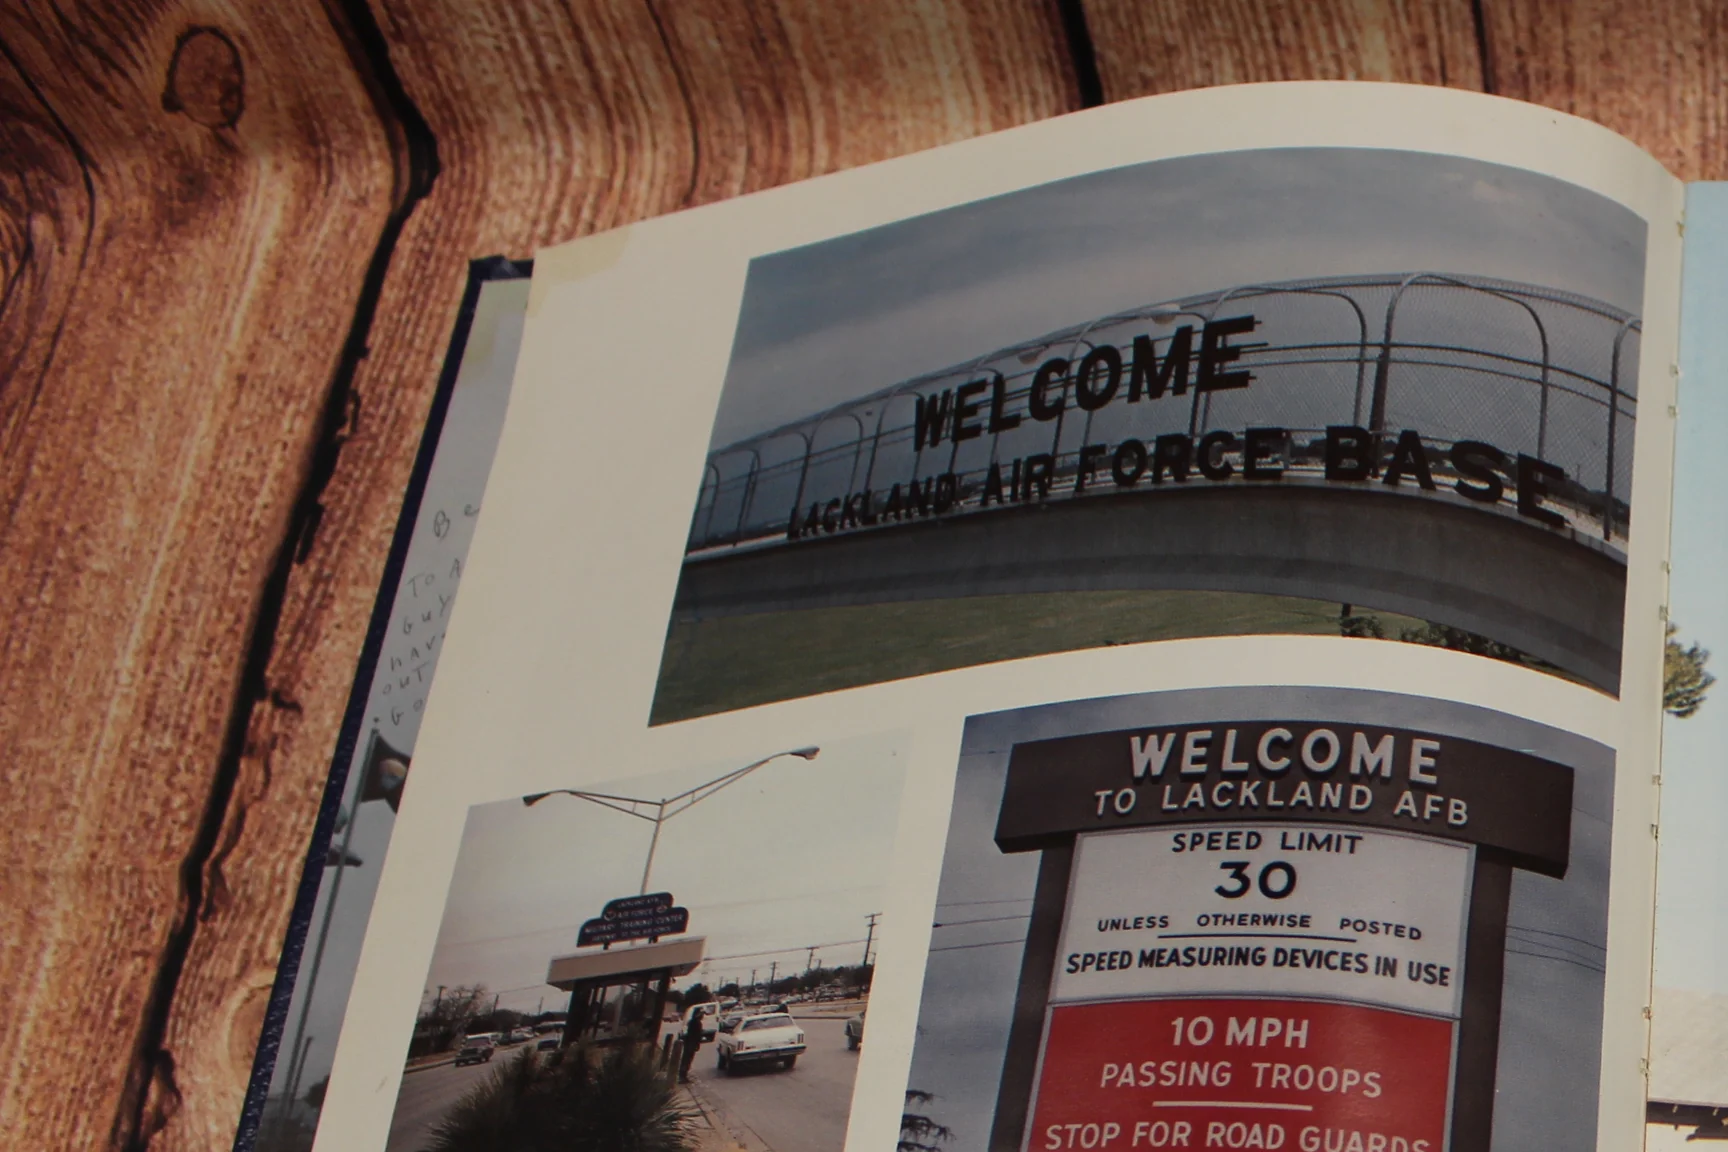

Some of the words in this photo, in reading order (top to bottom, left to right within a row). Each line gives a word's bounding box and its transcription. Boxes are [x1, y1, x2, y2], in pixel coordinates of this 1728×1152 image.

[912, 315, 1260, 452] WELCOME
[787, 473, 956, 541] LACKLAND
[980, 453, 1052, 506] AIR
[1075, 427, 1287, 492] FORCE
[1325, 425, 1566, 528] BASE
[1129, 727, 1442, 785] WELCOME
[1095, 788, 1137, 815] TO
[1162, 781, 1373, 811] LACKLAND
[1394, 791, 1469, 826] AFB
[1171, 831, 1262, 854] SPEED
[1280, 831, 1363, 855] LIMIT
[1214, 861, 1297, 900] 30
[1097, 915, 1170, 932] UNLESS
[1197, 914, 1312, 929] OTHERWISE
[1340, 918, 1422, 940] POSTED
[1066, 951, 1133, 974] SPEED
[1138, 947, 1267, 970] MEASURING
[1273, 949, 1369, 975] DEVICES
[1374, 956, 1397, 979] IN
[1407, 962, 1451, 988] USE
[1170, 1016, 1213, 1047] 10
[1224, 1018, 1309, 1049] MPH
[1101, 1062, 1232, 1089] PASSING
[1251, 1064, 1382, 1098] TROOPS
[1045, 1123, 1120, 1150] STOP
[1131, 1122, 1191, 1147] FOR
[1205, 1123, 1286, 1151] ROAD
